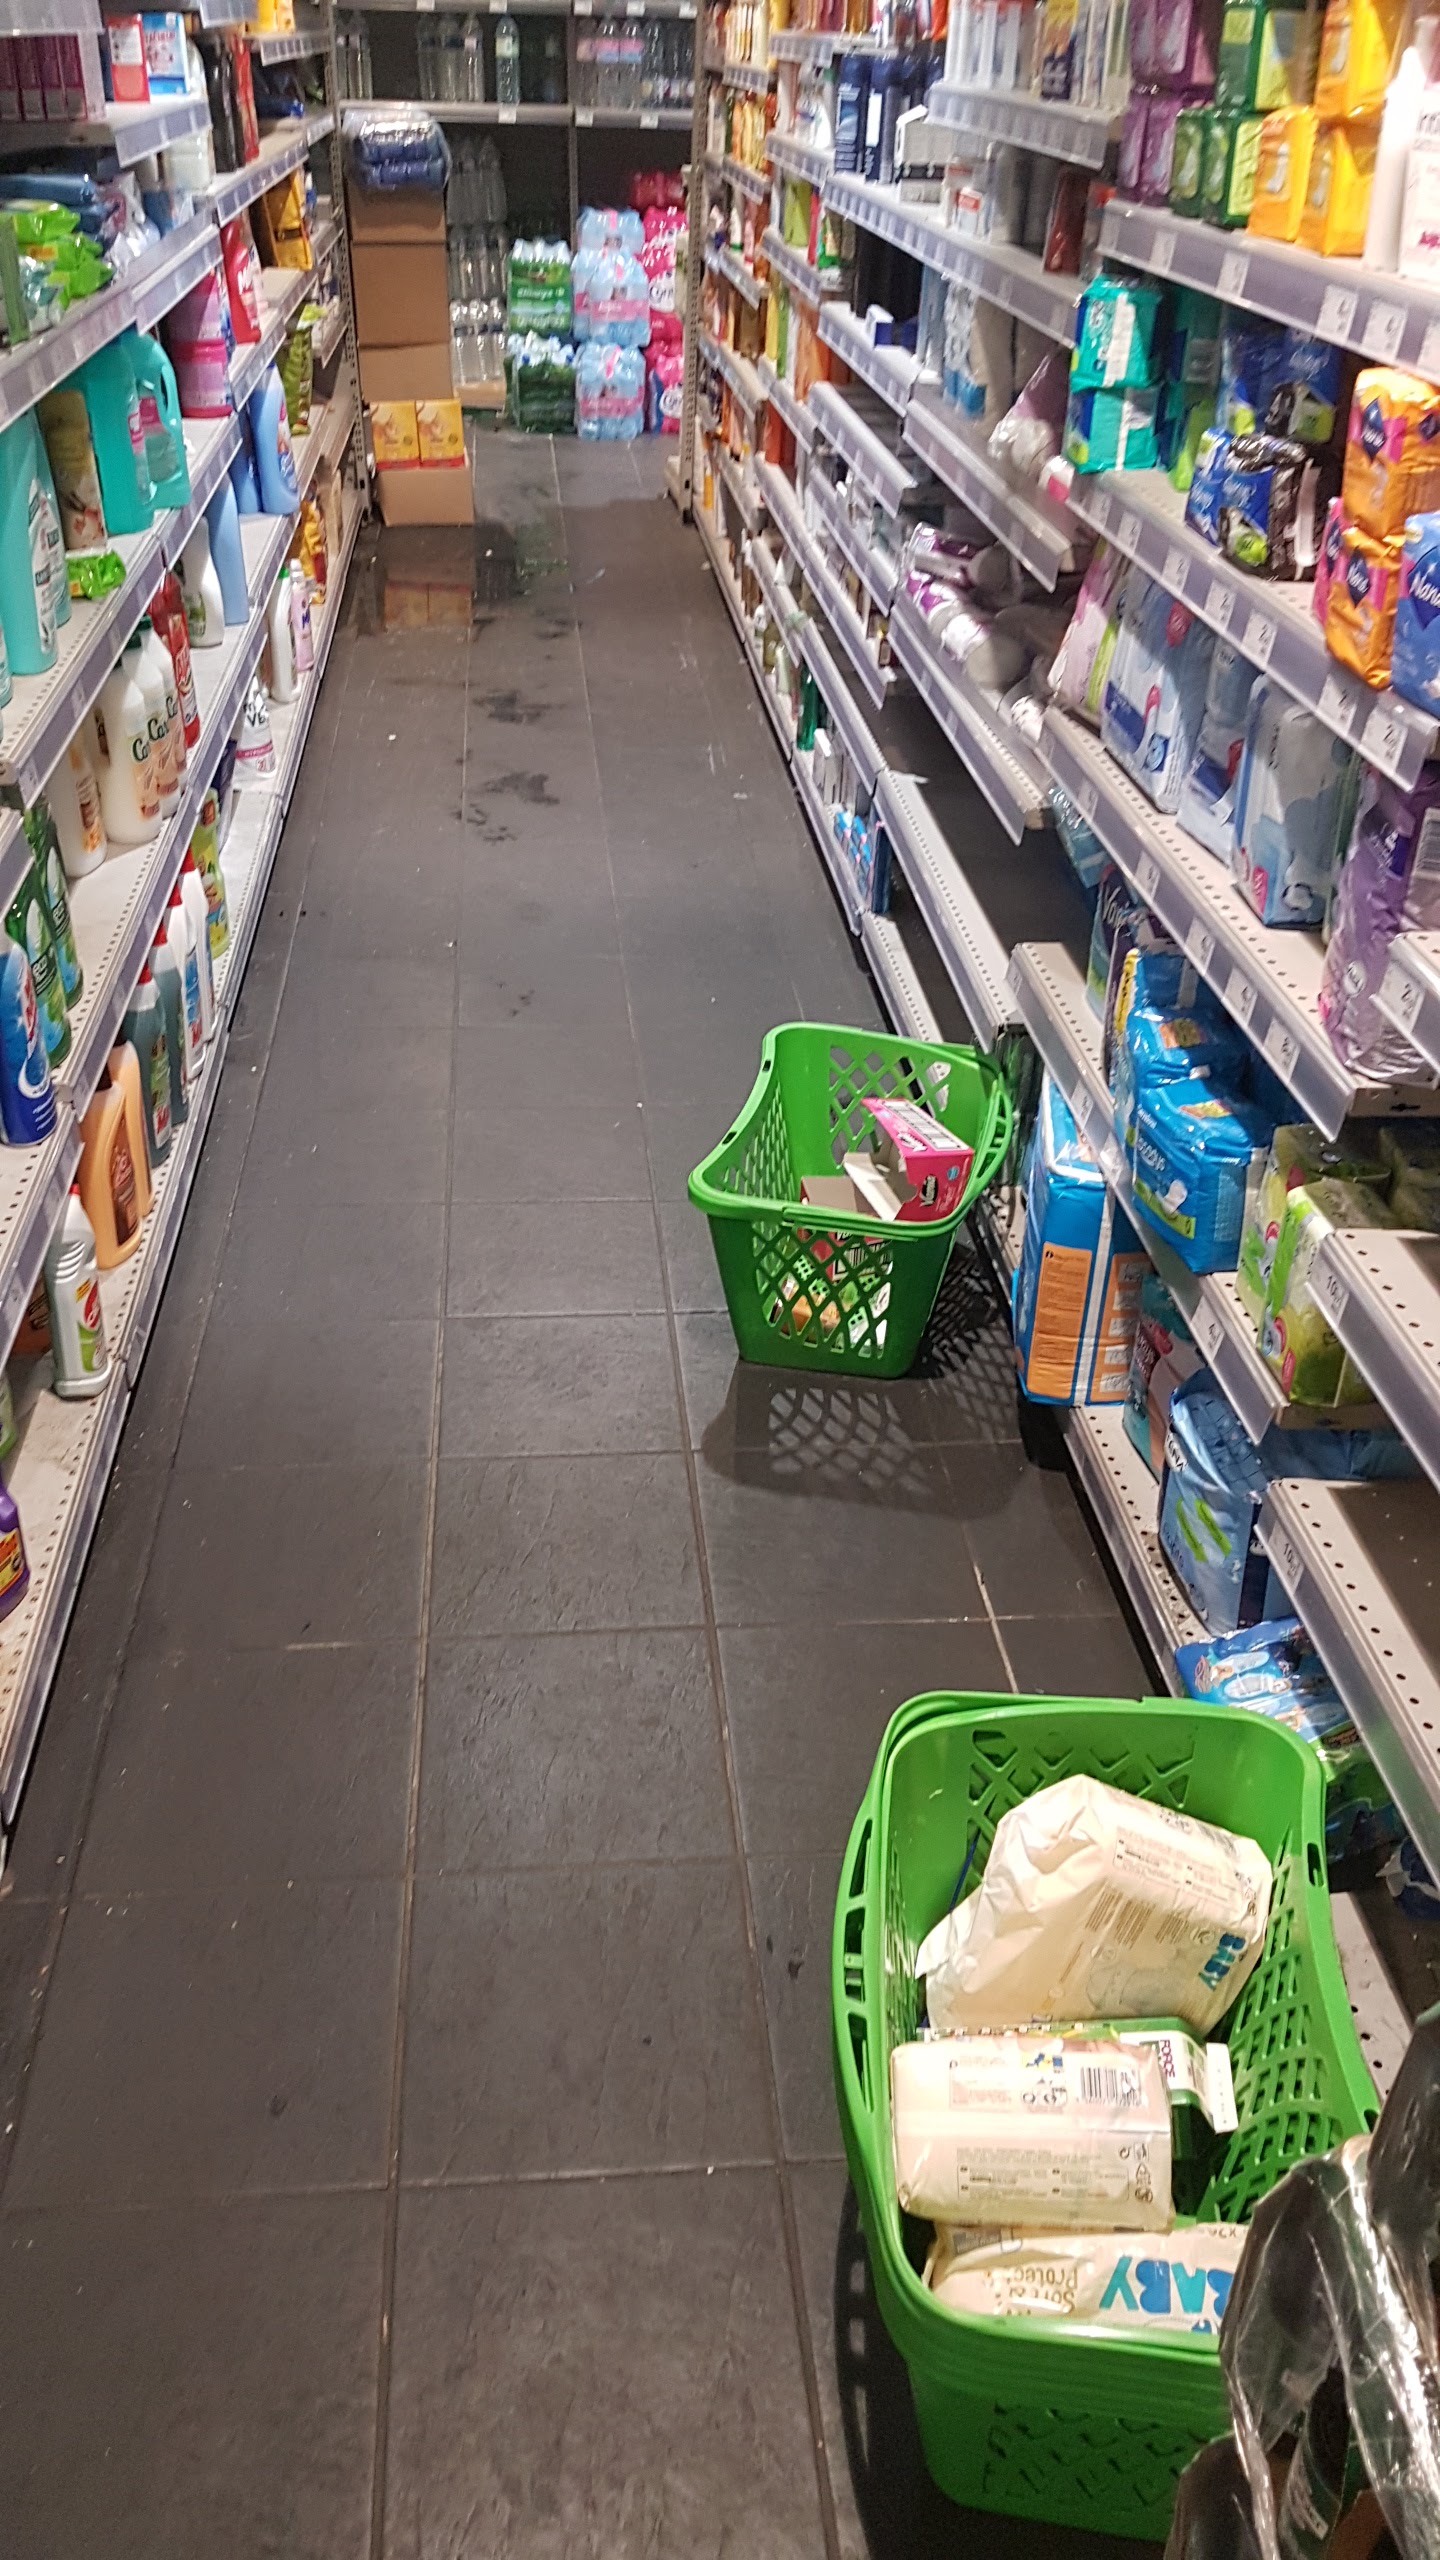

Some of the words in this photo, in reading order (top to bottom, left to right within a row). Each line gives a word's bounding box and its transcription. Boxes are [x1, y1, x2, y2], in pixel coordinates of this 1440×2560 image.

[1198, 1932, 1247, 1992] BABY
[1159, 2038, 1176, 2078] FORCE
[1005, 2267, 1078, 2290] Protec
[1099, 2256, 1234, 2316] BABY
